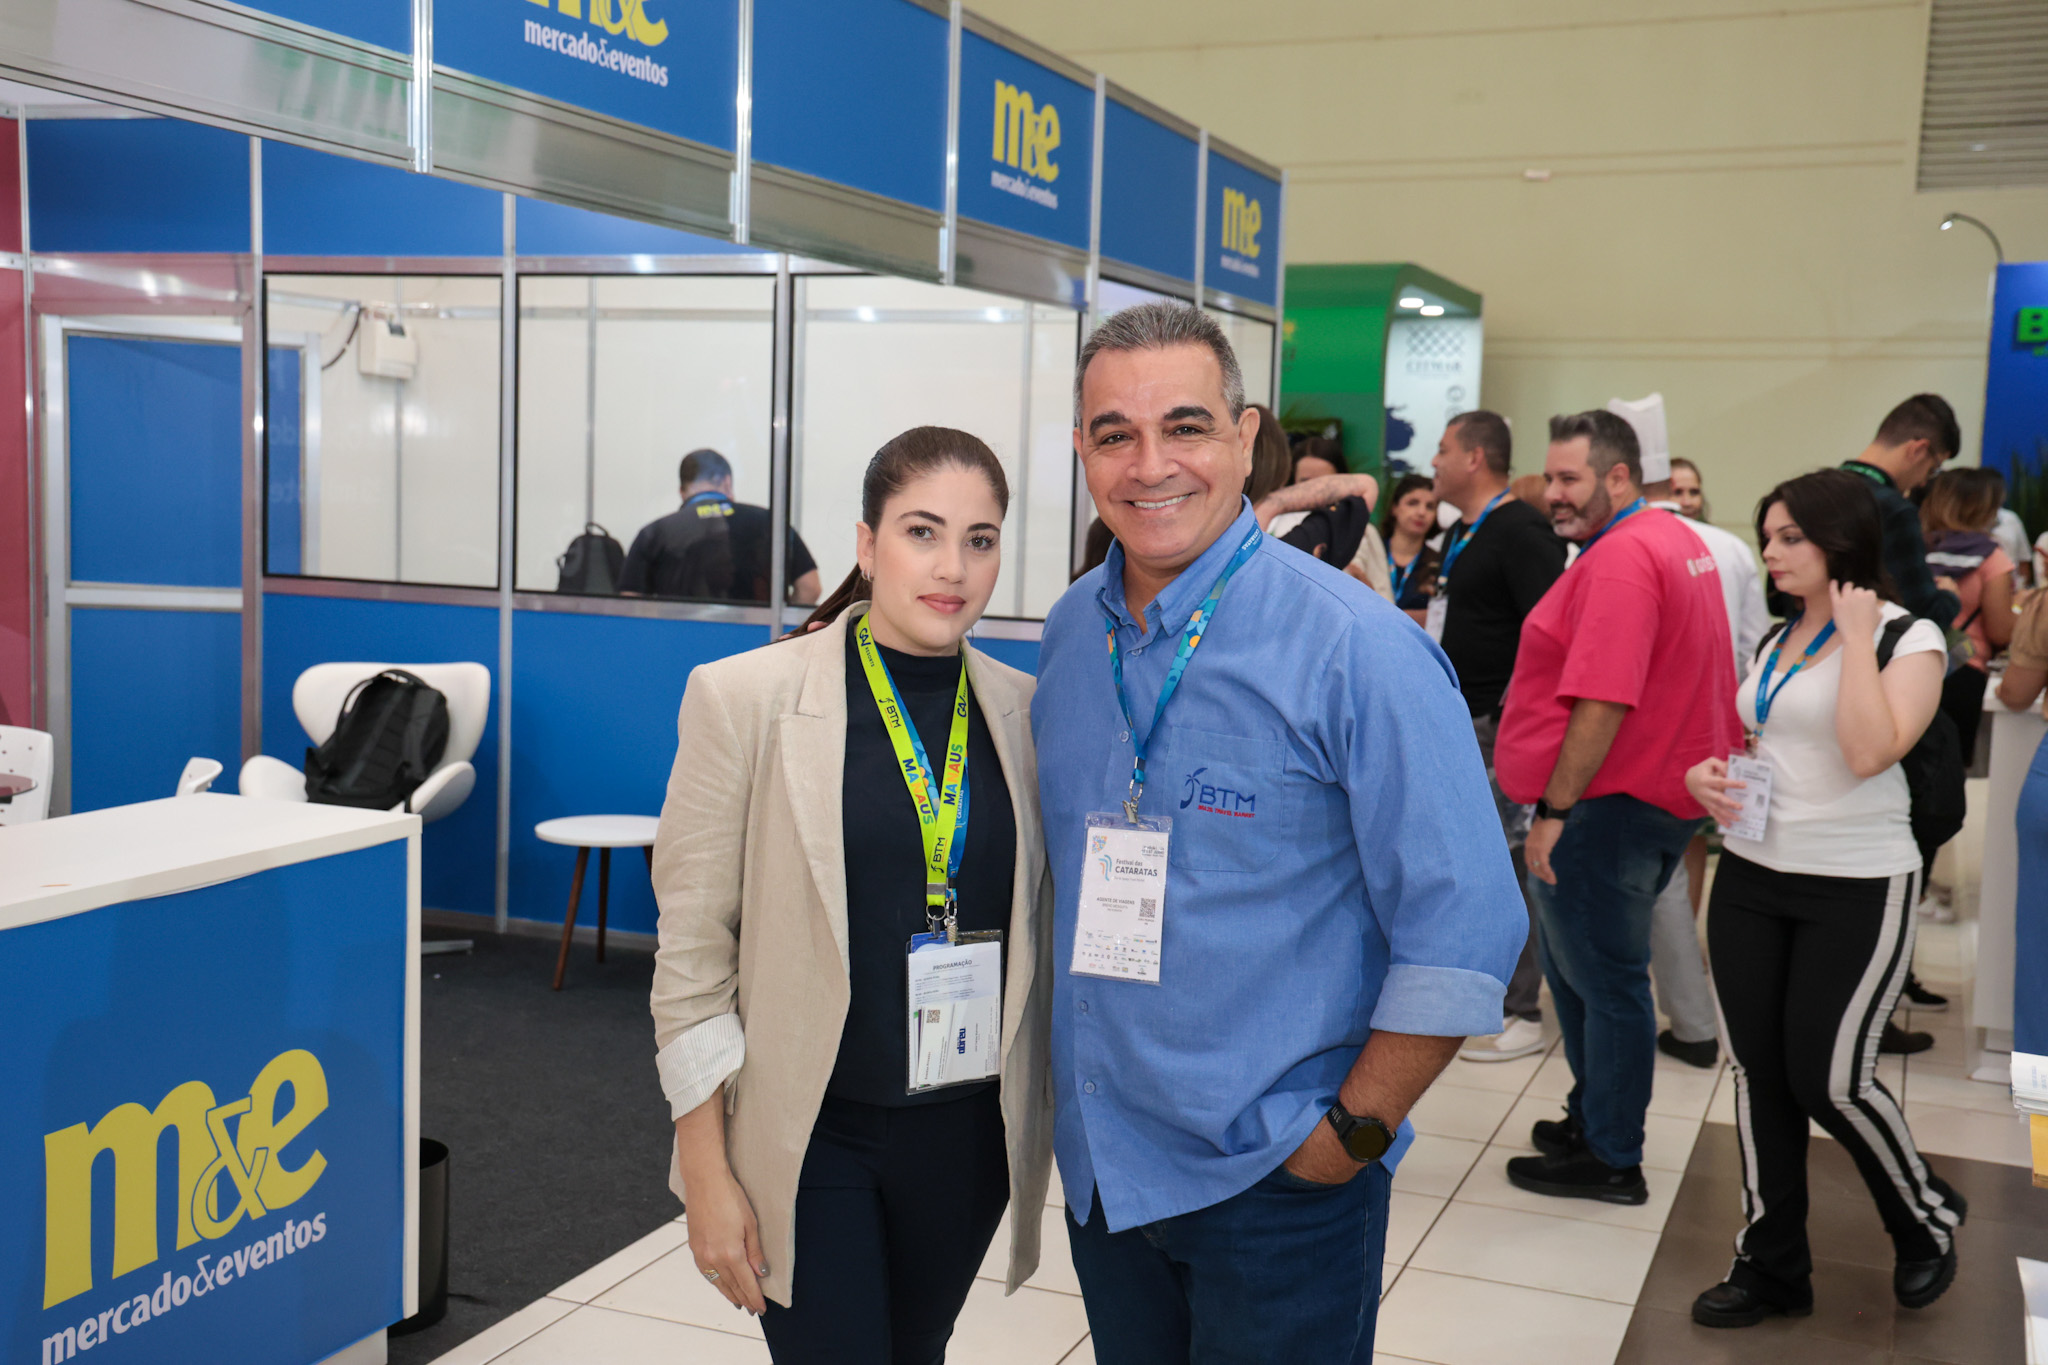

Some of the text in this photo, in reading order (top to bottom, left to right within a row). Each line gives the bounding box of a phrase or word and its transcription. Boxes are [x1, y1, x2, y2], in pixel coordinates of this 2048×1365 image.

[524, 19, 669, 87] mercado&eventos
[992, 79, 1061, 183] m&e
[886, 705, 902, 729] BTM
[943, 743, 963, 806] MANAUS
[902, 758, 934, 825] MANAUS
[1199, 784, 1256, 812] BTM
[932, 837, 946, 863] BTM
[1115, 858, 1134, 866] Festival
[1115, 866, 1158, 877] CATARATAS
[933, 959, 972, 971] PROGRAMAÇÃO
[956, 1027, 967, 1055] abreu
[43, 1048, 329, 1311] m&e
[42, 1212, 327, 1365] mercado&eventos
